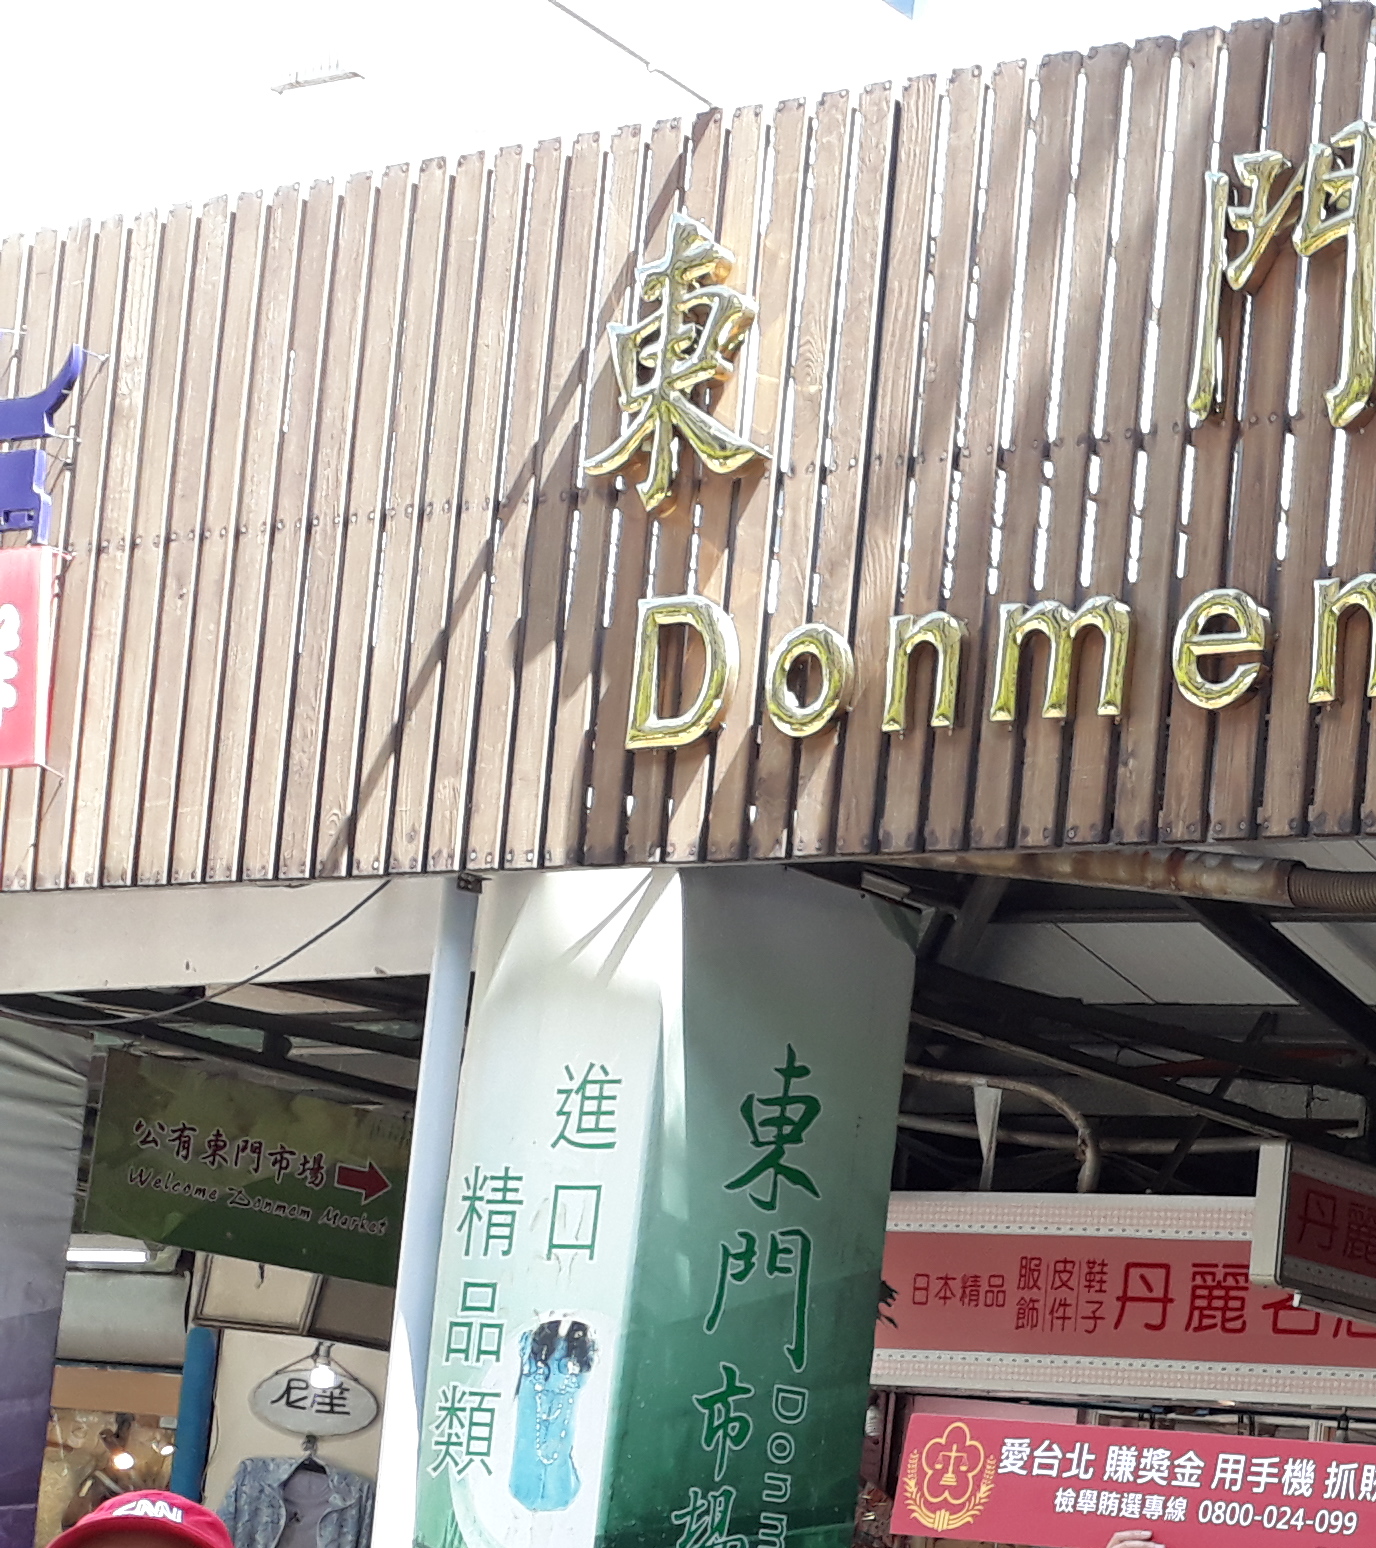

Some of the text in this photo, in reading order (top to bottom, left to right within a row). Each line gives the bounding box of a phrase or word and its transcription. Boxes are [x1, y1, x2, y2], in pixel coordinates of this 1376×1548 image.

[133, 1118, 327, 1190] 公有東門市場
[544, 1061, 624, 1263] 進口
[128, 1165, 218, 1202] Welcome
[318, 1206, 389, 1237] Market
[428, 1165, 525, 1478] 精品類
[912, 1272, 1007, 1308] 日本精品
[1016, 1255, 1043, 1331] 服飾
[1049, 1257, 1077, 1333] 皮件
[1081, 1258, 1110, 1335] 鞋子
[997, 1437, 1097, 1481] 愛台北
[1104, 1445, 1201, 1490] 賺獎金
[1210, 1453, 1315, 1499] 用手機
[1053, 1487, 1358, 1535] 檢舉賄選專線 0800-024-099
